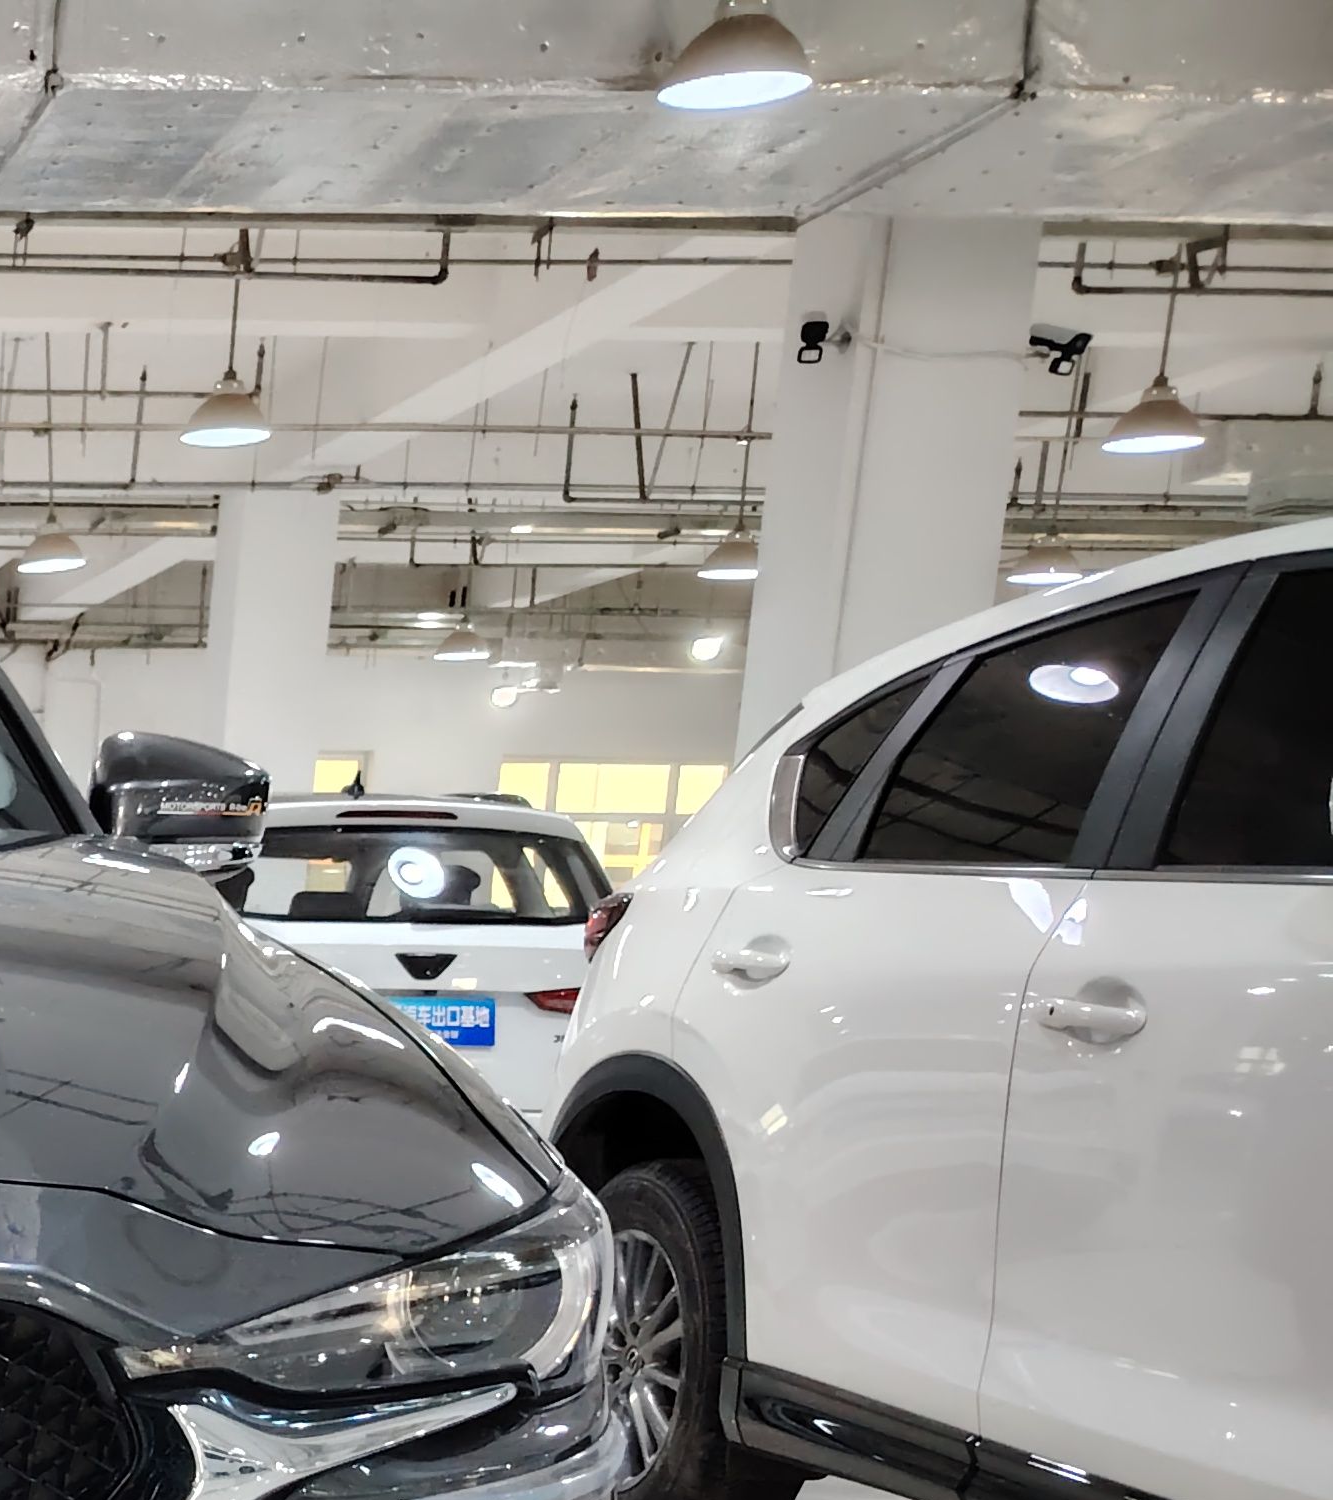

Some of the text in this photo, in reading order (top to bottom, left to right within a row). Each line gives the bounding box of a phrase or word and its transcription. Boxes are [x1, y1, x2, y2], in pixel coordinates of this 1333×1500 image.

[397, 1005, 490, 1027] 汽车出口基地
